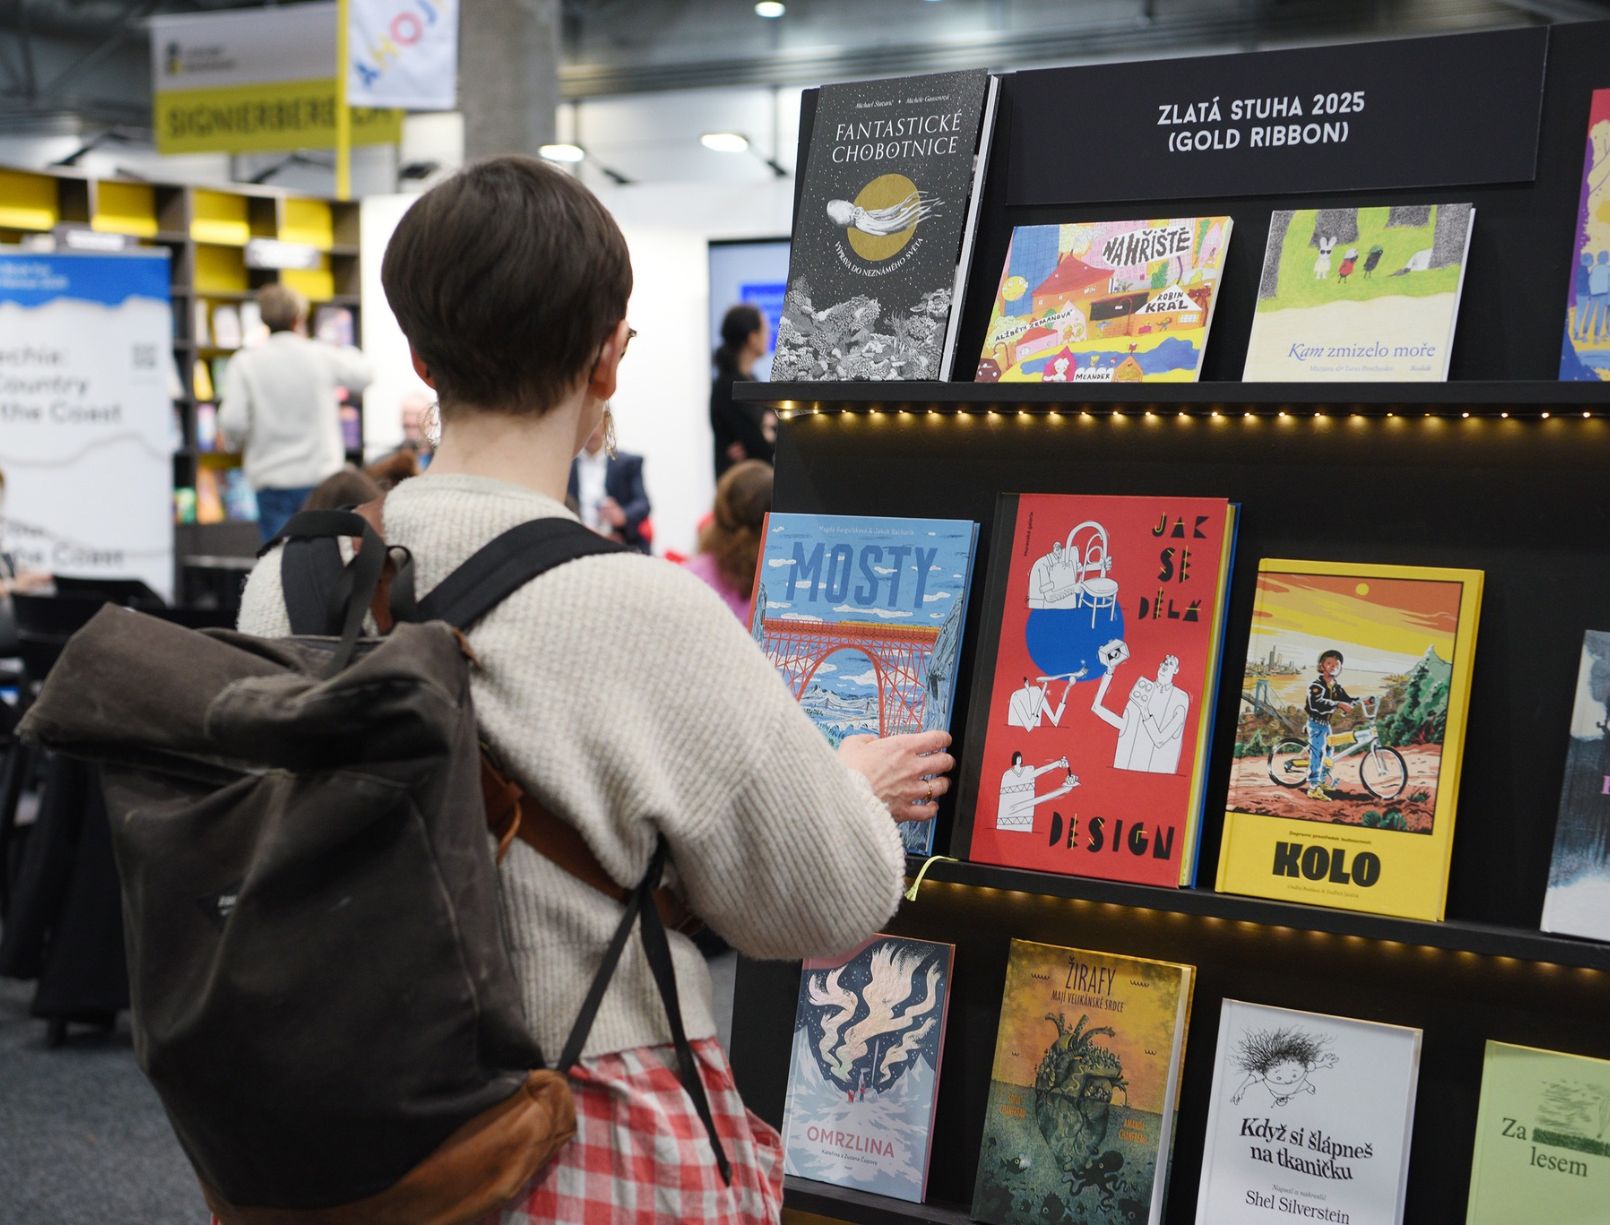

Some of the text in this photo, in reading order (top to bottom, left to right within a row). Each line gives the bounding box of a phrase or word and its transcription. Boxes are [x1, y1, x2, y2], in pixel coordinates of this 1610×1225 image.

[1157, 91, 1365, 125] ZLATÁ STUHA 2025
[835, 110, 962, 141] FANTASTICKÉ
[1168, 121, 1349, 152] (GOLD RIBBON)
[832, 136, 959, 163] CHOBOTNICE
[851, 264, 862, 275] DO
[1145, 299, 1188, 313] KRÁL
[1158, 291, 1184, 301] ROBIN
[1288, 341, 1436, 361] Kam zmizelo moře
[1152, 512, 1209, 539] JAK
[785, 541, 938, 609] MOSTY
[1157, 545, 1192, 583] SE
[1049, 811, 1175, 860] DESIGN
[1272, 841, 1381, 888] KOLO
[1065, 956, 1116, 996] ŽIRAFY
[807, 1126, 894, 1158] OMRZLINA
[1239, 1117, 1374, 1160] Když si šlápneš
[1502, 1117, 1527, 1141] Za
[1250, 1146, 1354, 1180] na tkaničku
[1529, 1146, 1588, 1178] lesem
[1245, 1190, 1350, 1225] Shel Silverstein
